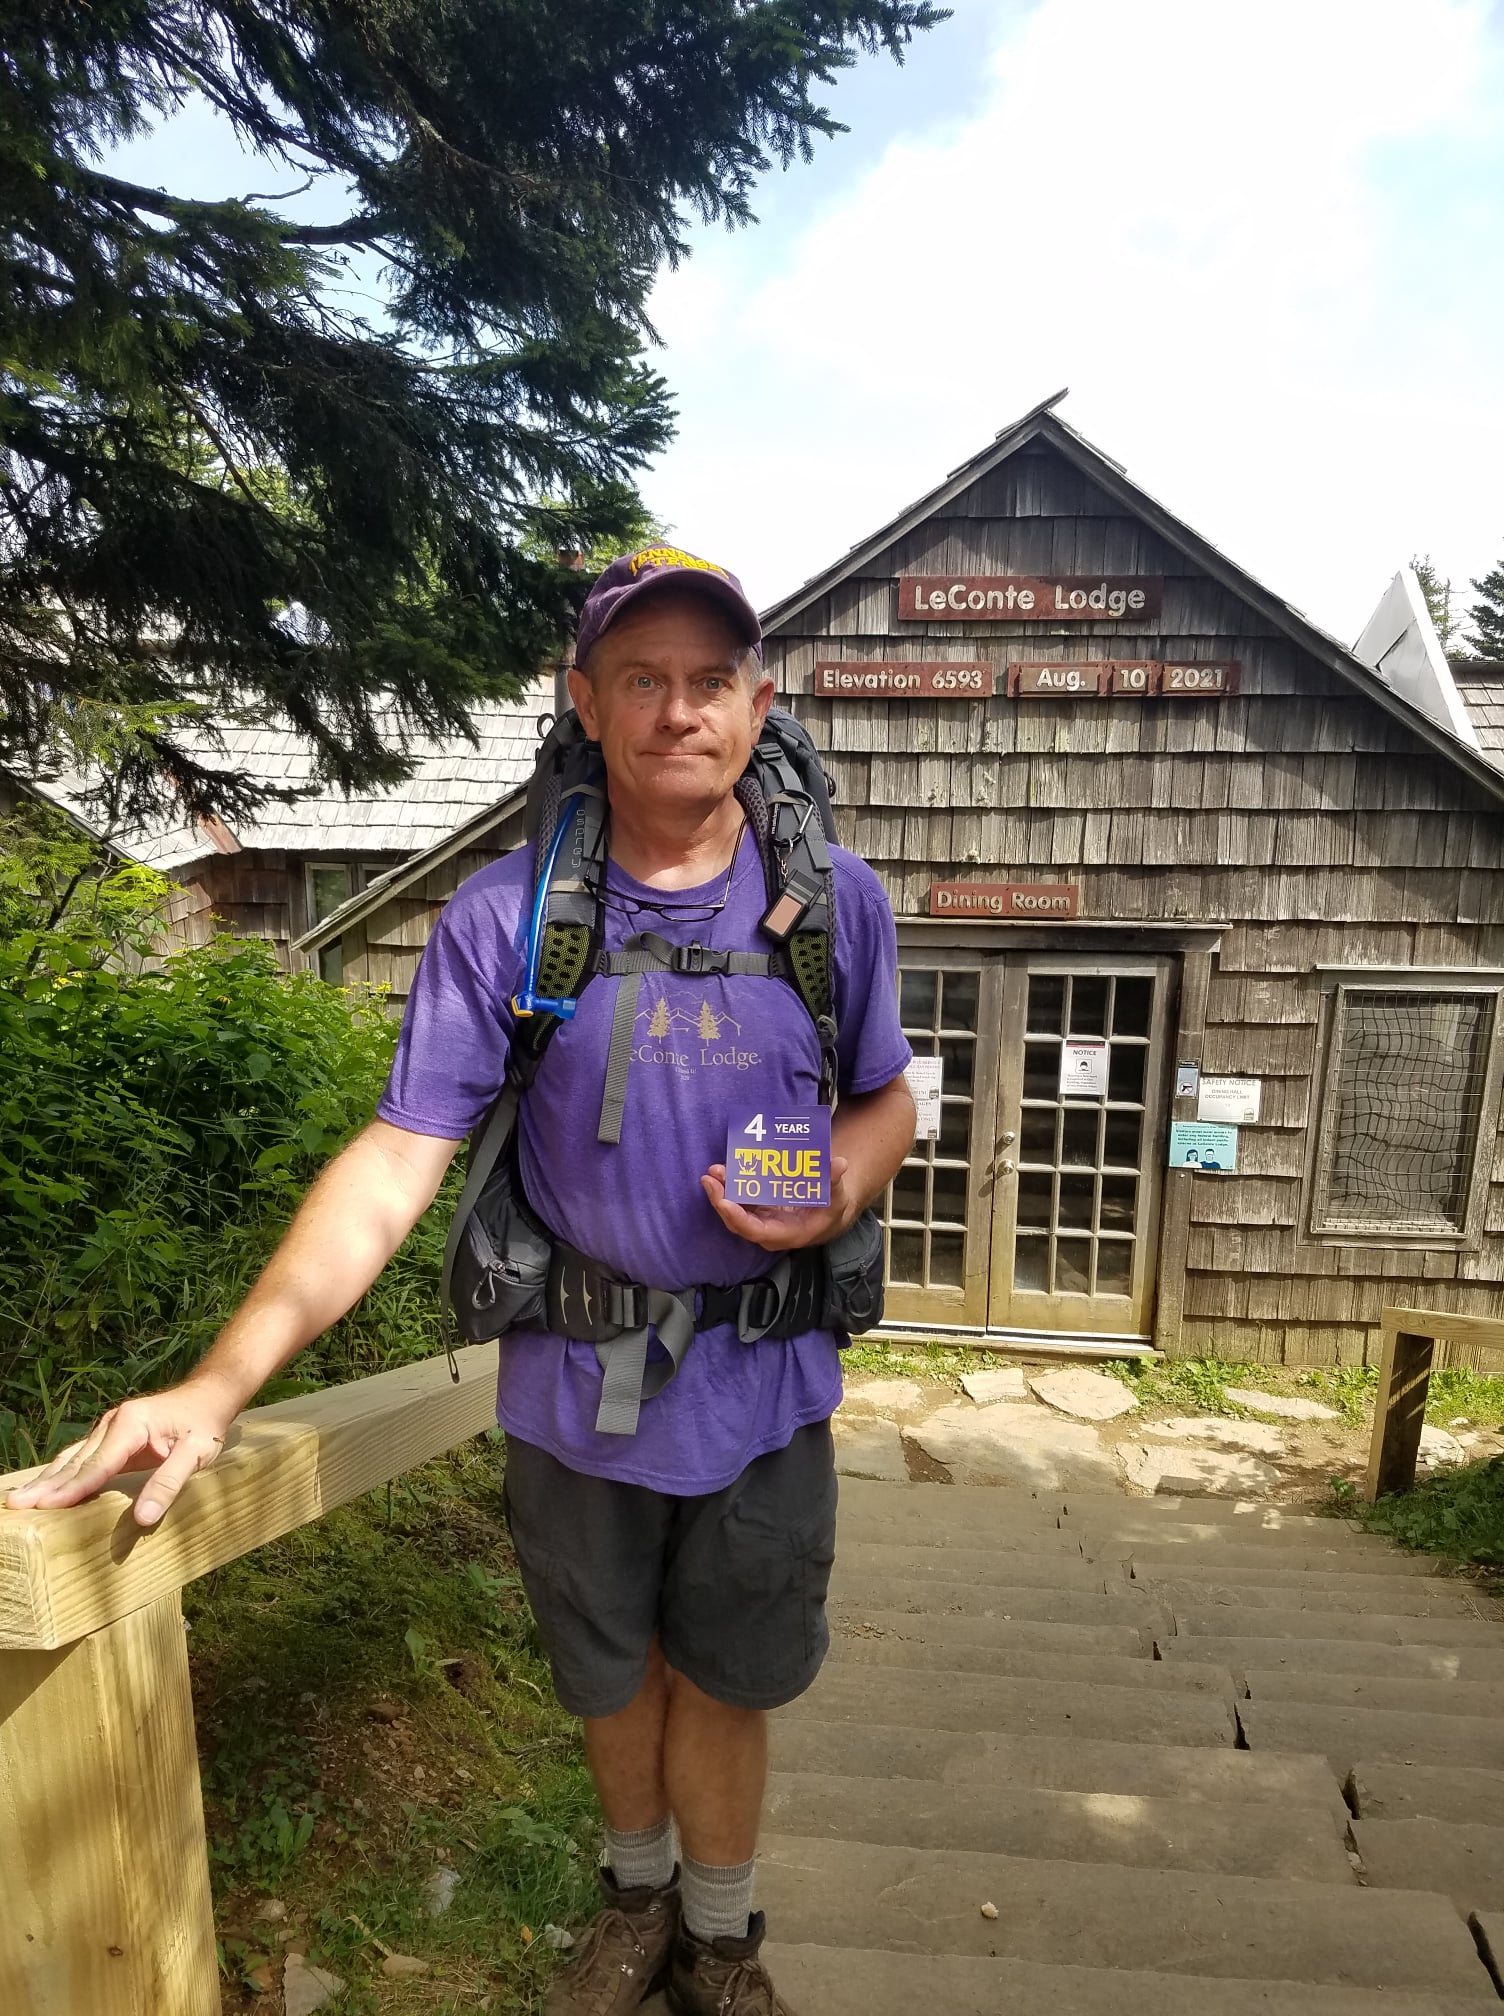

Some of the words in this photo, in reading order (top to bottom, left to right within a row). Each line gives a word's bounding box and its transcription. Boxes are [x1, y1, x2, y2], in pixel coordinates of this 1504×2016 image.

[915, 584, 1035, 610] LeConte
[1054, 582, 1146, 617] Lodge
[823, 669, 921, 689] Elevation
[931, 670, 983, 689] 6593
[1036, 668, 1086, 691] Aug.
[1120, 669, 1146, 688] 10
[1169, 668, 1222, 688] 2021
[937, 889, 1003, 914] Dining
[1011, 892, 1071, 912] Room
[629, 1044, 689, 1067] eConte
[744, 1114, 767, 1142] 4
[774, 1123, 811, 1134] YEARS
[734, 1148, 821, 1177] TRUE
[733, 1179, 761, 1198] TO
[769, 1180, 821, 1199] TECH
